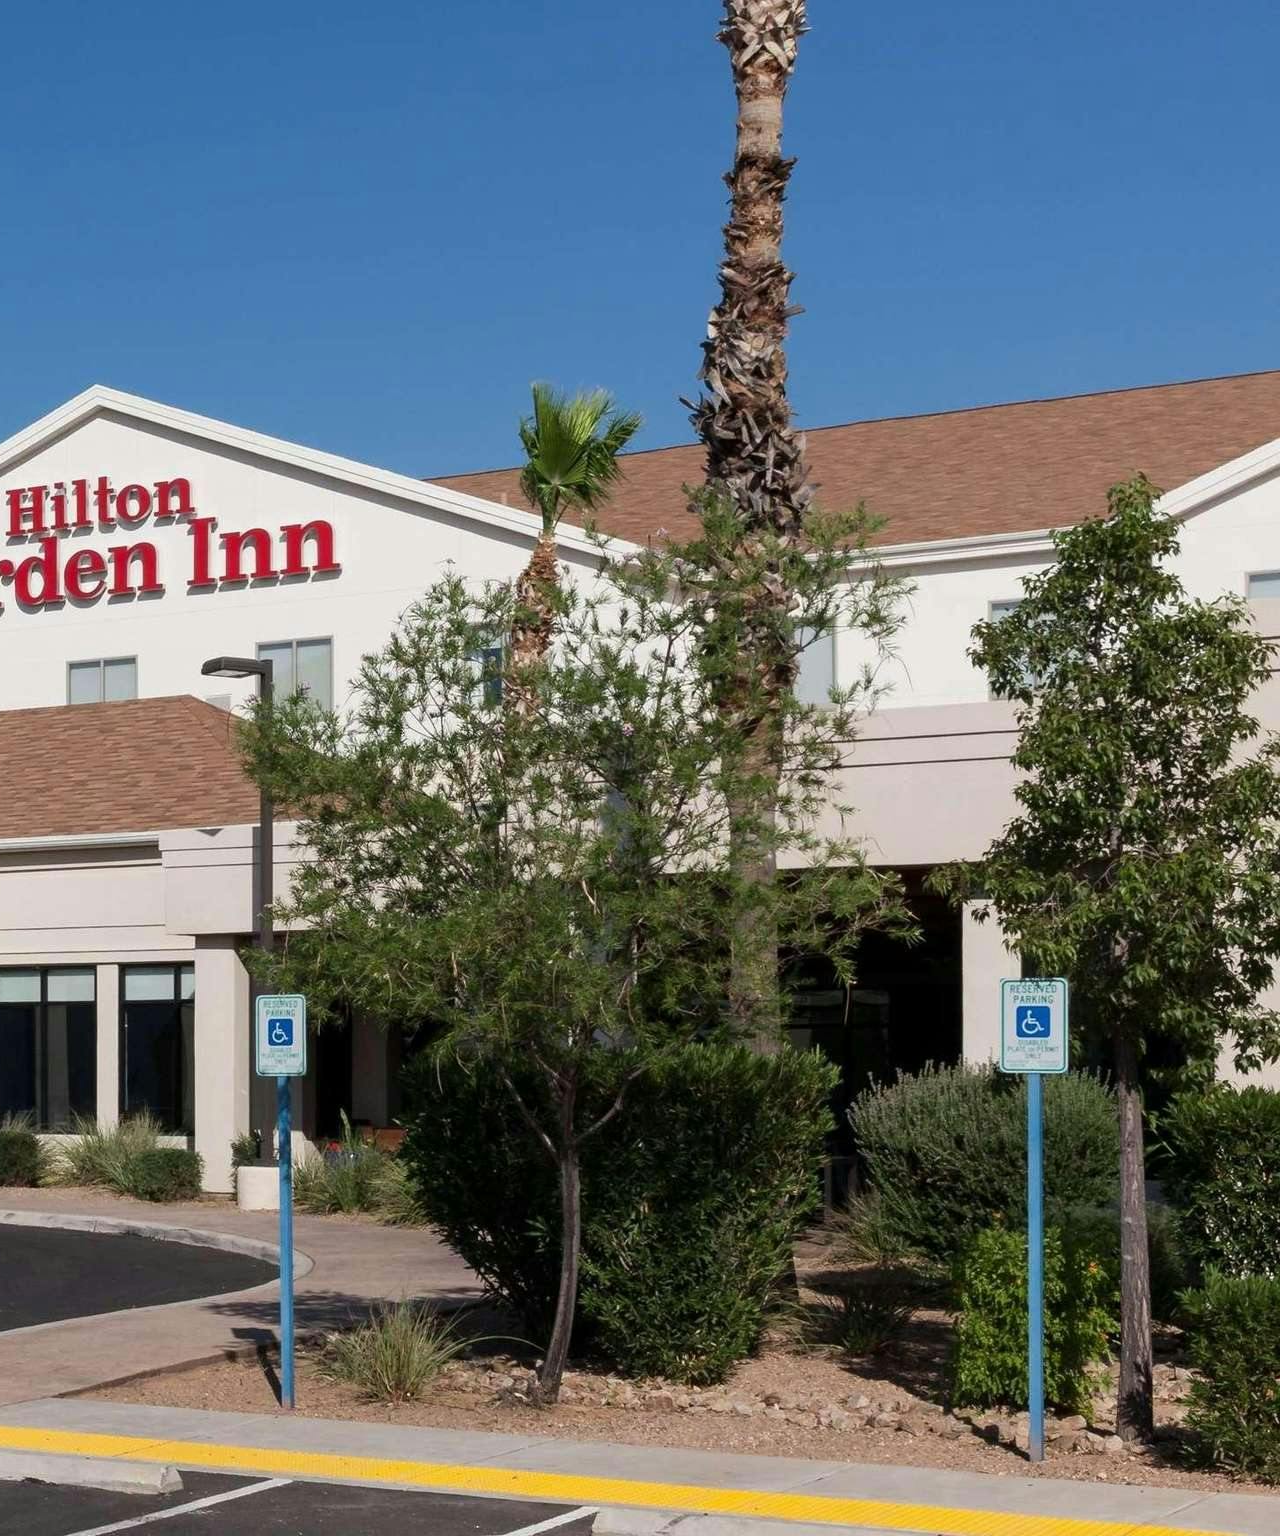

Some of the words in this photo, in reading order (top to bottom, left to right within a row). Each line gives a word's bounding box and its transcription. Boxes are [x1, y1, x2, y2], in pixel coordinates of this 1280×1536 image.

[5, 476, 196, 538] Hilton
[187, 517, 341, 587] Inn
[1010, 984, 1057, 994] RESERVED
[263, 1000, 298, 1008] RESERVED
[1013, 995, 1054, 1004] PARKING
[265, 1009, 296, 1017] PARKING
